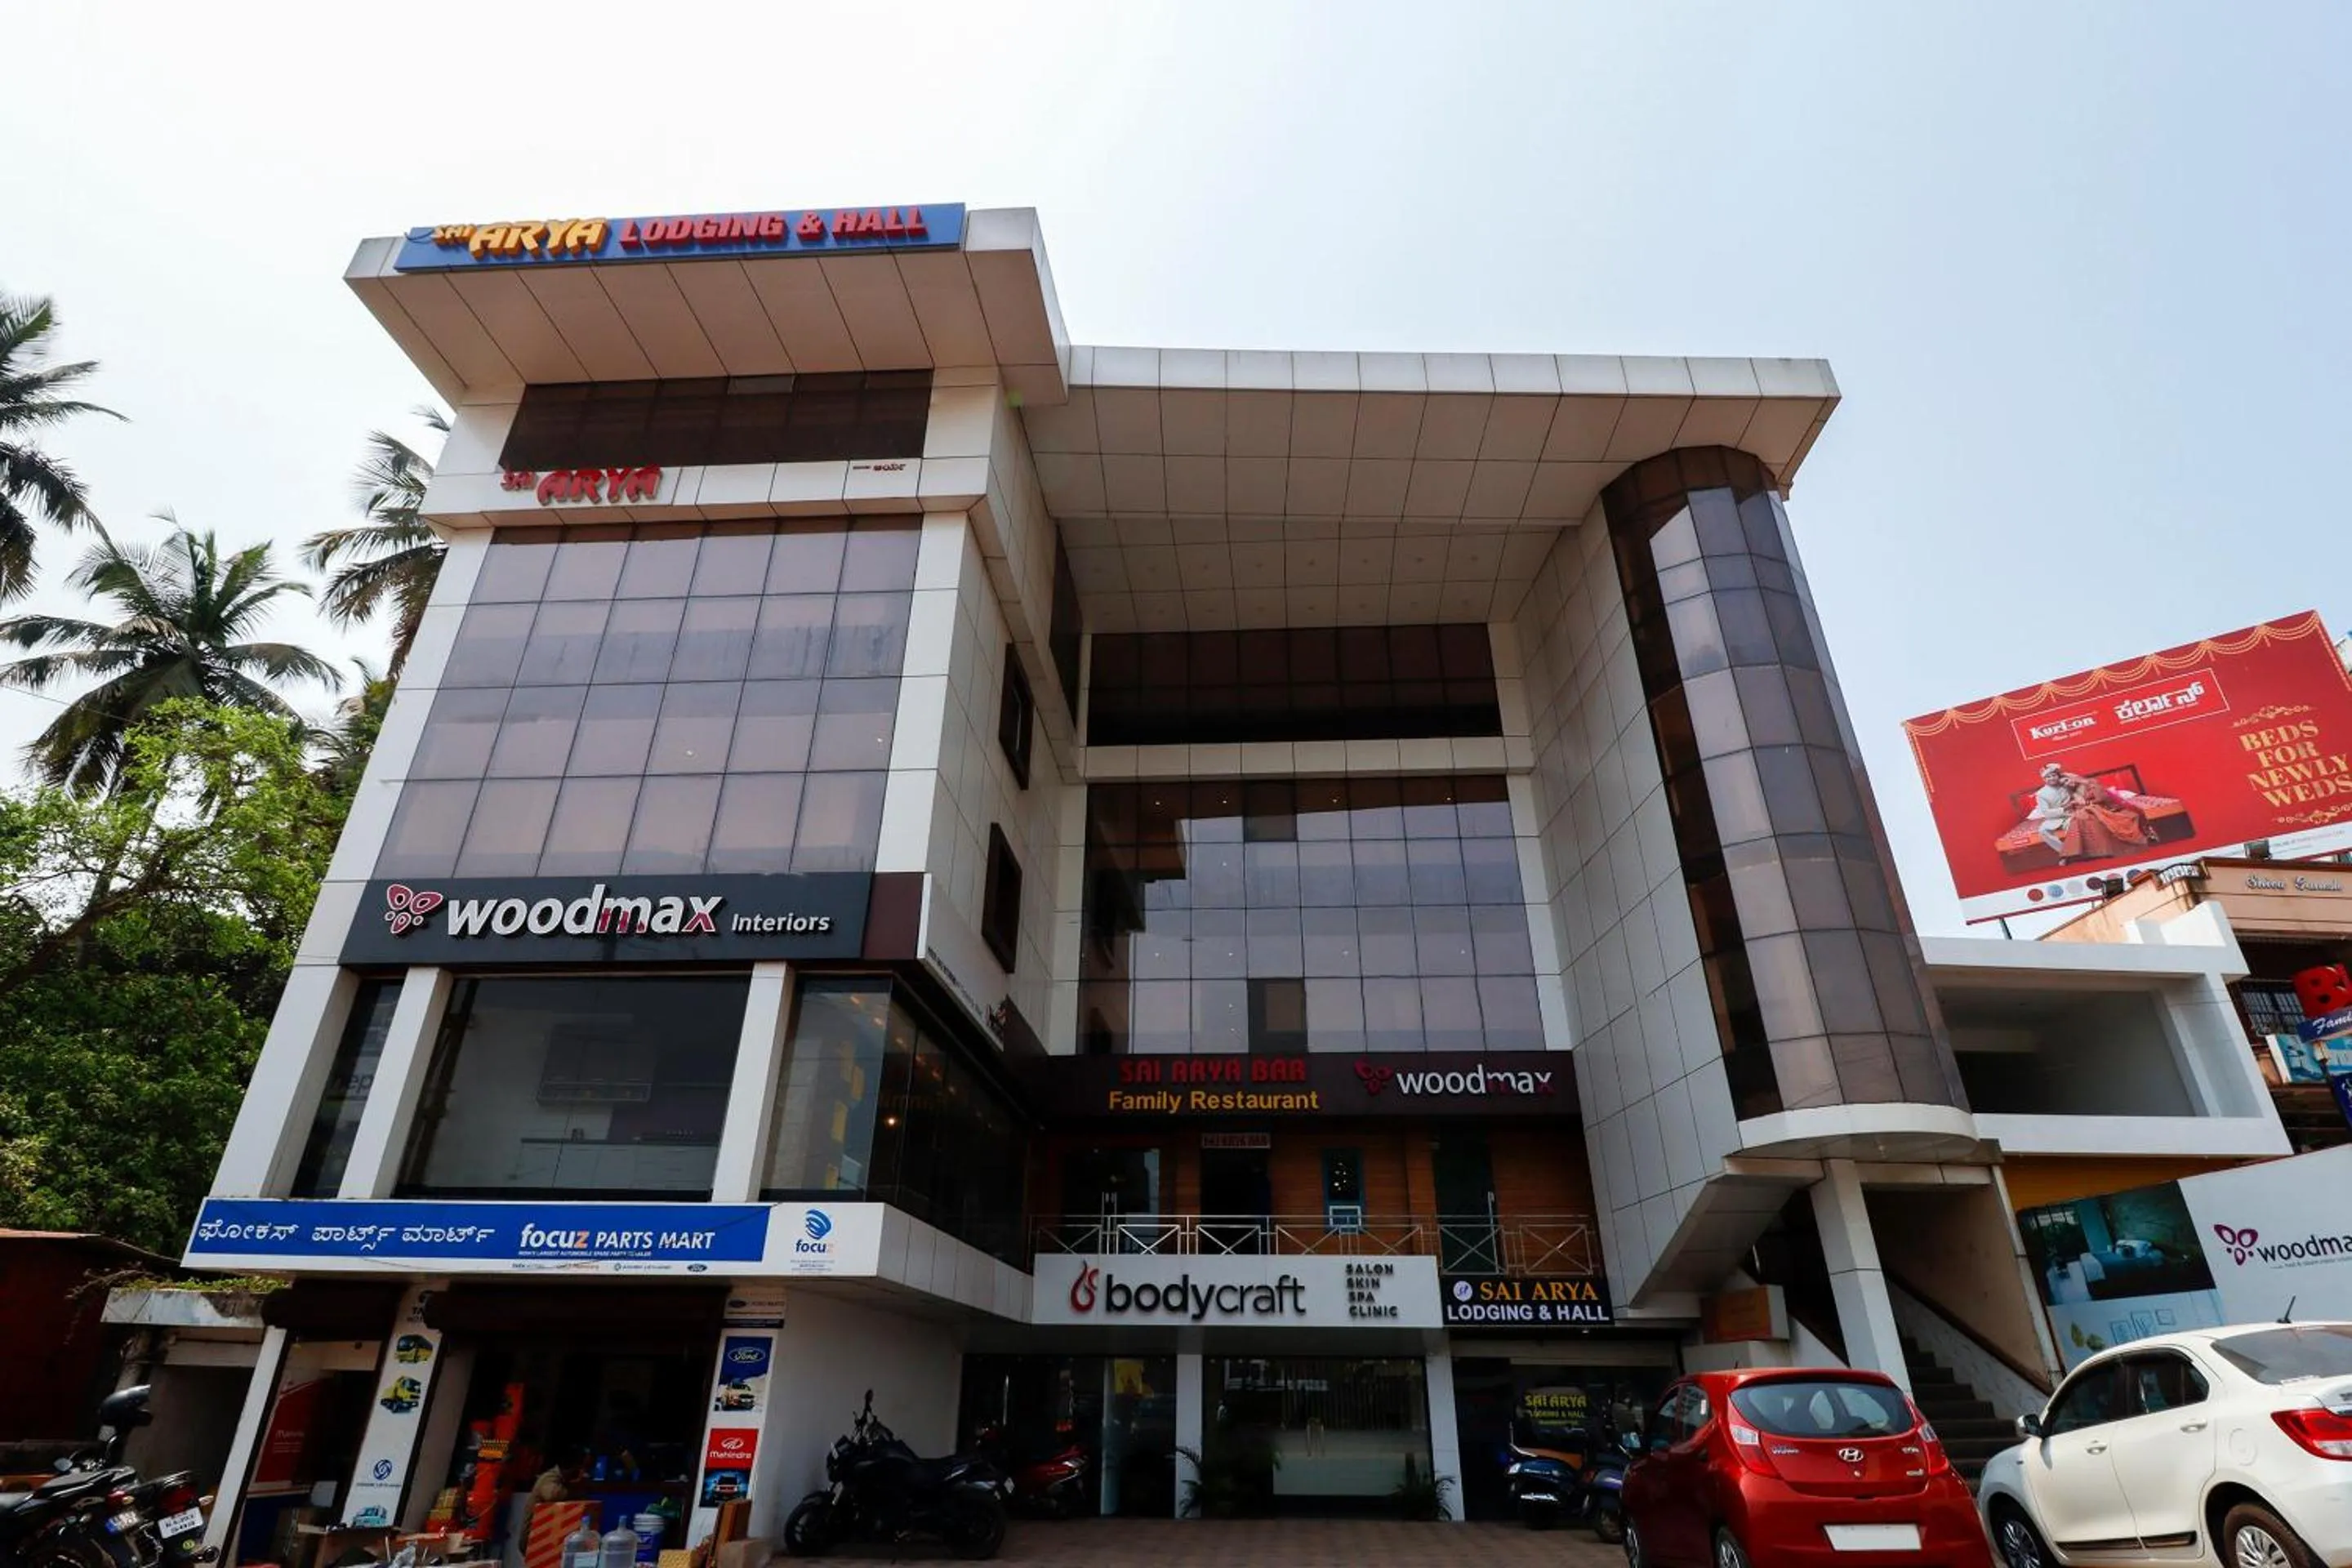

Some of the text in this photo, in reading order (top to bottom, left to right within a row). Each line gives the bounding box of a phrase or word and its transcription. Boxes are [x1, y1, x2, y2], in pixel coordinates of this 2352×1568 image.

[468, 217, 609, 260] ARYA
[619, 213, 786, 249] LODGING
[797, 211, 827, 240] &
[832, 206, 929, 239] HALL
[537, 464, 662, 506] ARYA
[2239, 719, 2319, 751] BEDS
[2256, 741, 2319, 768] FOR
[2246, 754, 2349, 791] NEWLY
[2261, 774, 2352, 807] WEDS
[447, 884, 831, 936] woodmax Interiors
[1119, 1057, 1307, 1083] SAI ARYA BAR
[1396, 1065, 1553, 1096] woodmax
[1109, 1091, 1320, 1114] Family Restaurant
[519, 1223, 715, 1250] focuz PARTS MART
[2256, 1234, 2352, 1263] woodma
[1346, 1263, 1393, 1275] SALON
[1347, 1277, 1380, 1289] SKIN
[1480, 1281, 1523, 1301] SAI
[1532, 1280, 1599, 1301] ARYA
[1105, 1274, 1306, 1321] bodycraft
[1348, 1291, 1375, 1303] SPA
[1349, 1305, 1398, 1317] CLINIC
[1447, 1304, 1610, 1321] LODGING & HALL
